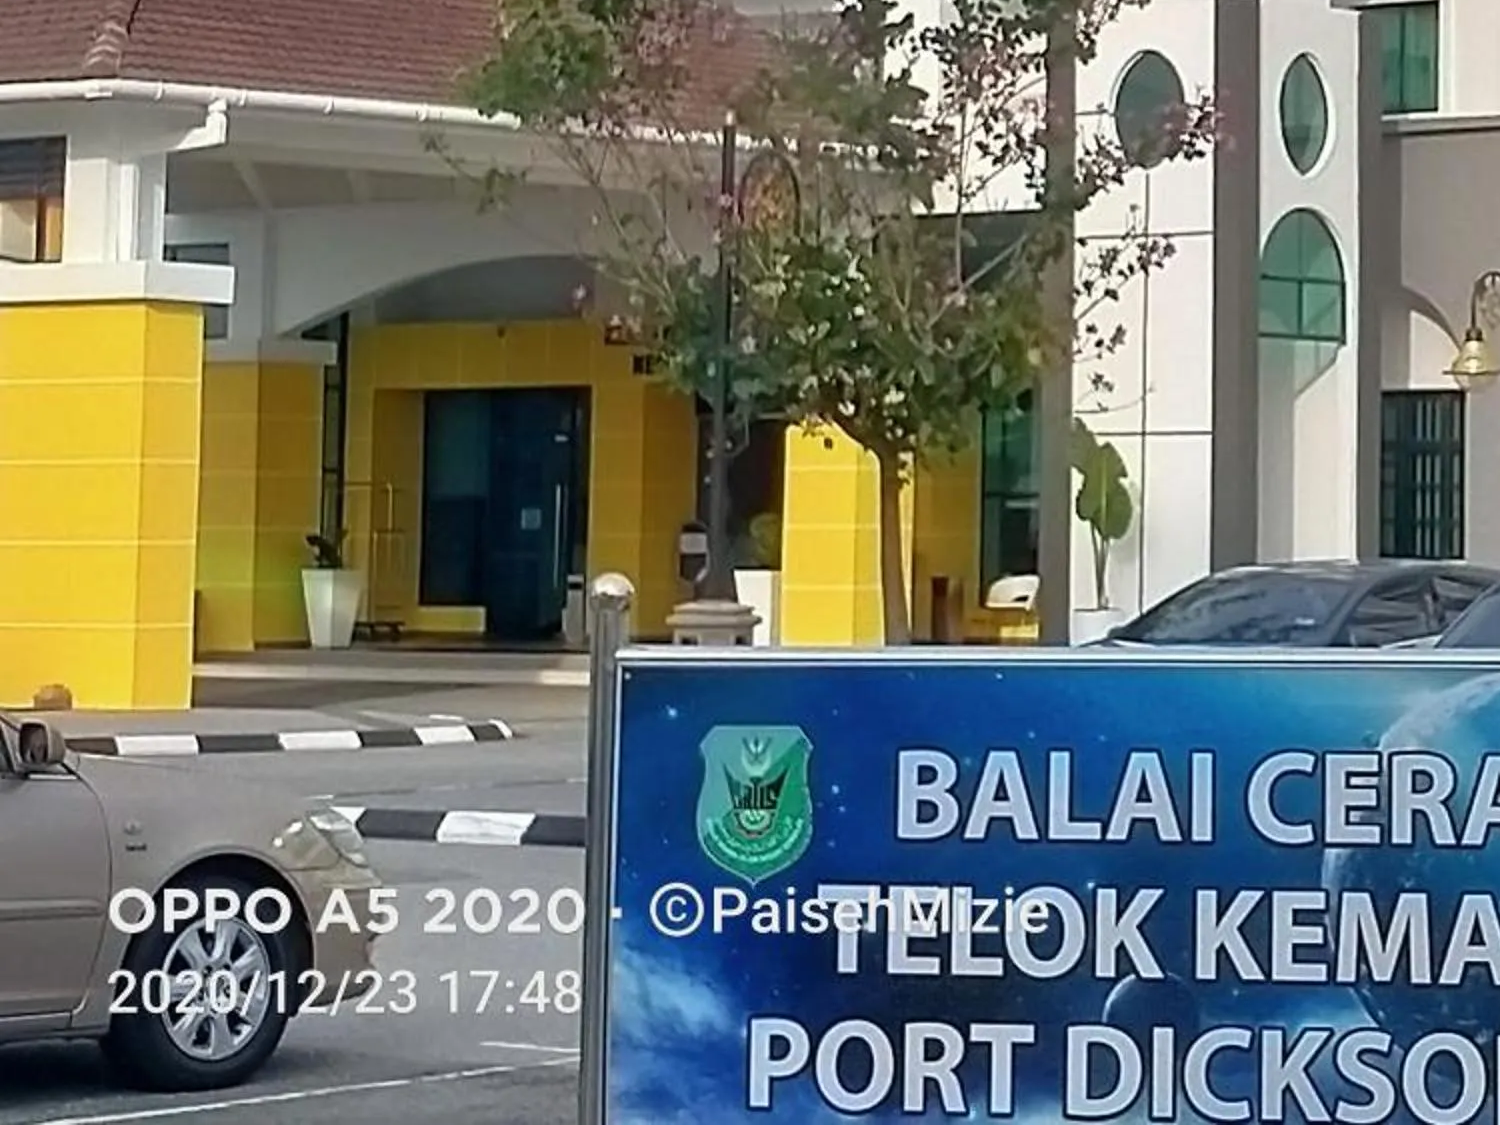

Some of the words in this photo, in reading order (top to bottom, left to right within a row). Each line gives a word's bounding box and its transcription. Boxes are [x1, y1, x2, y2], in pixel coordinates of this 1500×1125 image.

[894, 748, 1215, 845] BALAI
[817, 884, 1167, 979] TELOK
[747, 1017, 1035, 1115] PORT
